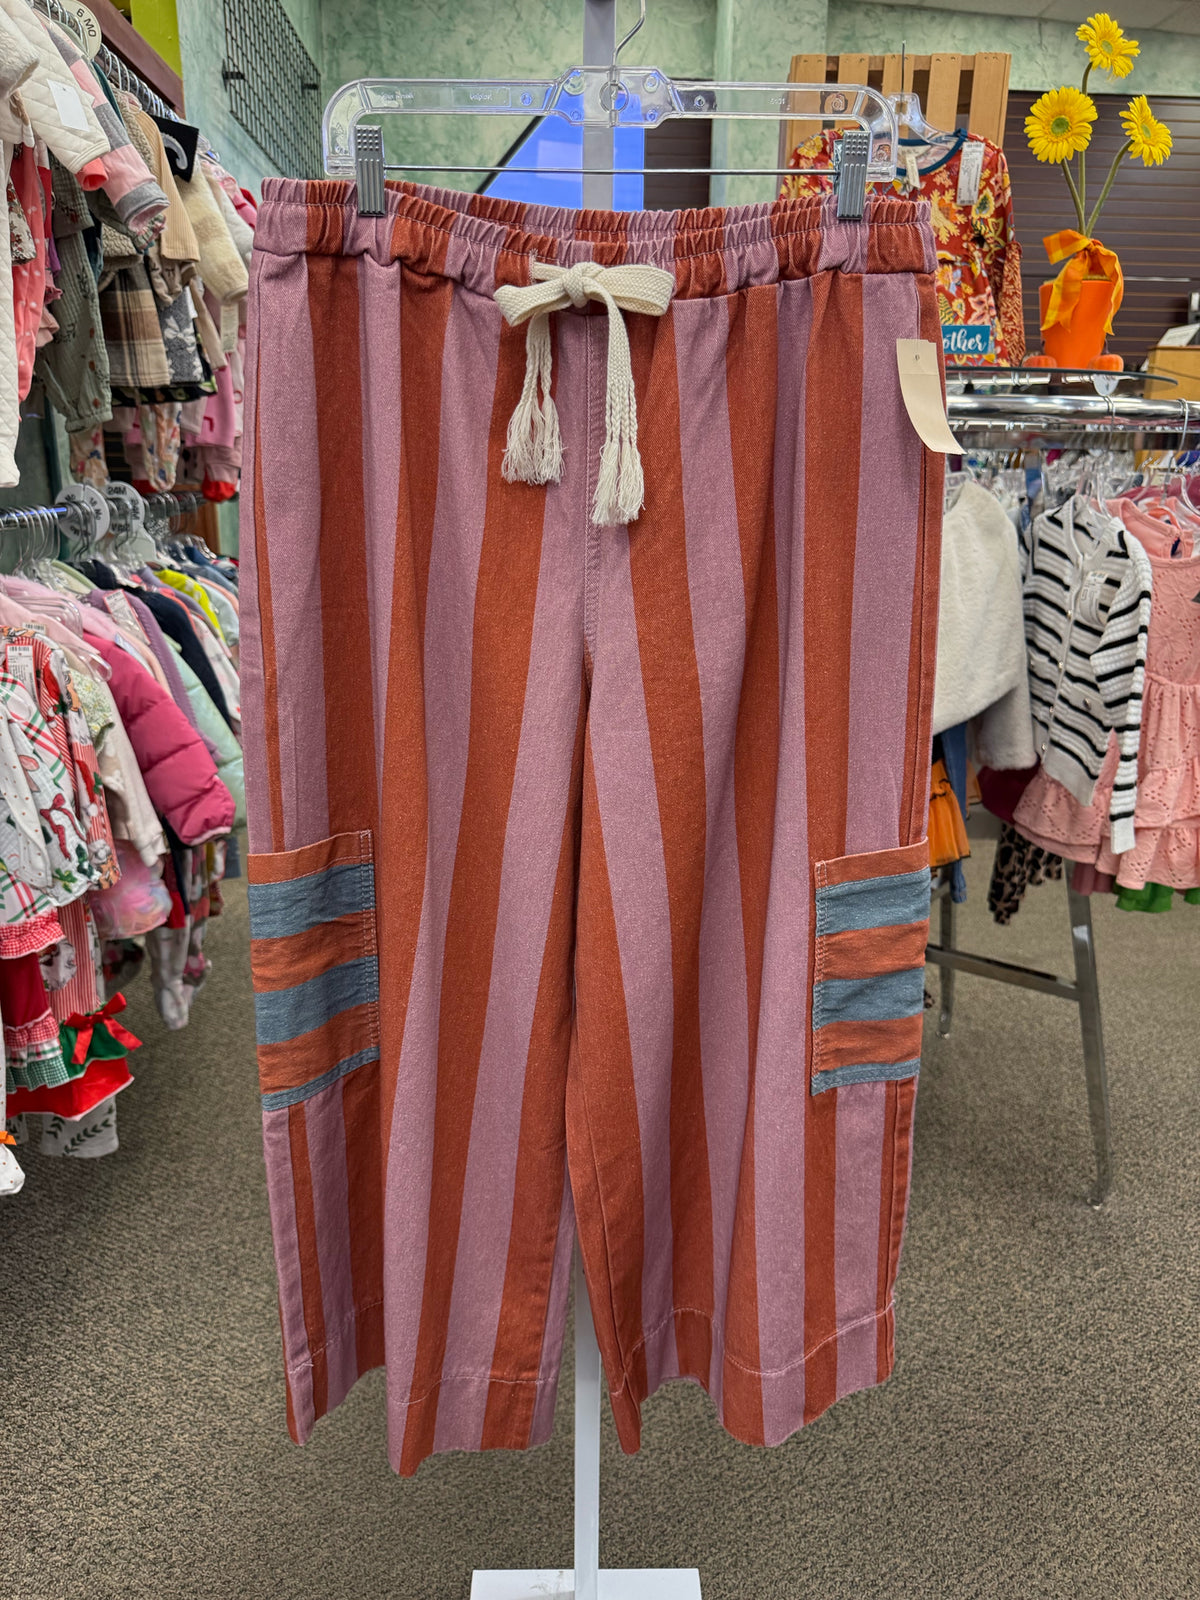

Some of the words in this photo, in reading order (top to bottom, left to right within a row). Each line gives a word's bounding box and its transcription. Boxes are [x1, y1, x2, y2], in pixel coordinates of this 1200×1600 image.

[76, 8, 85, 17] 6
[84, 18, 97, 37] MO
[106, 486, 127, 495] 24M
